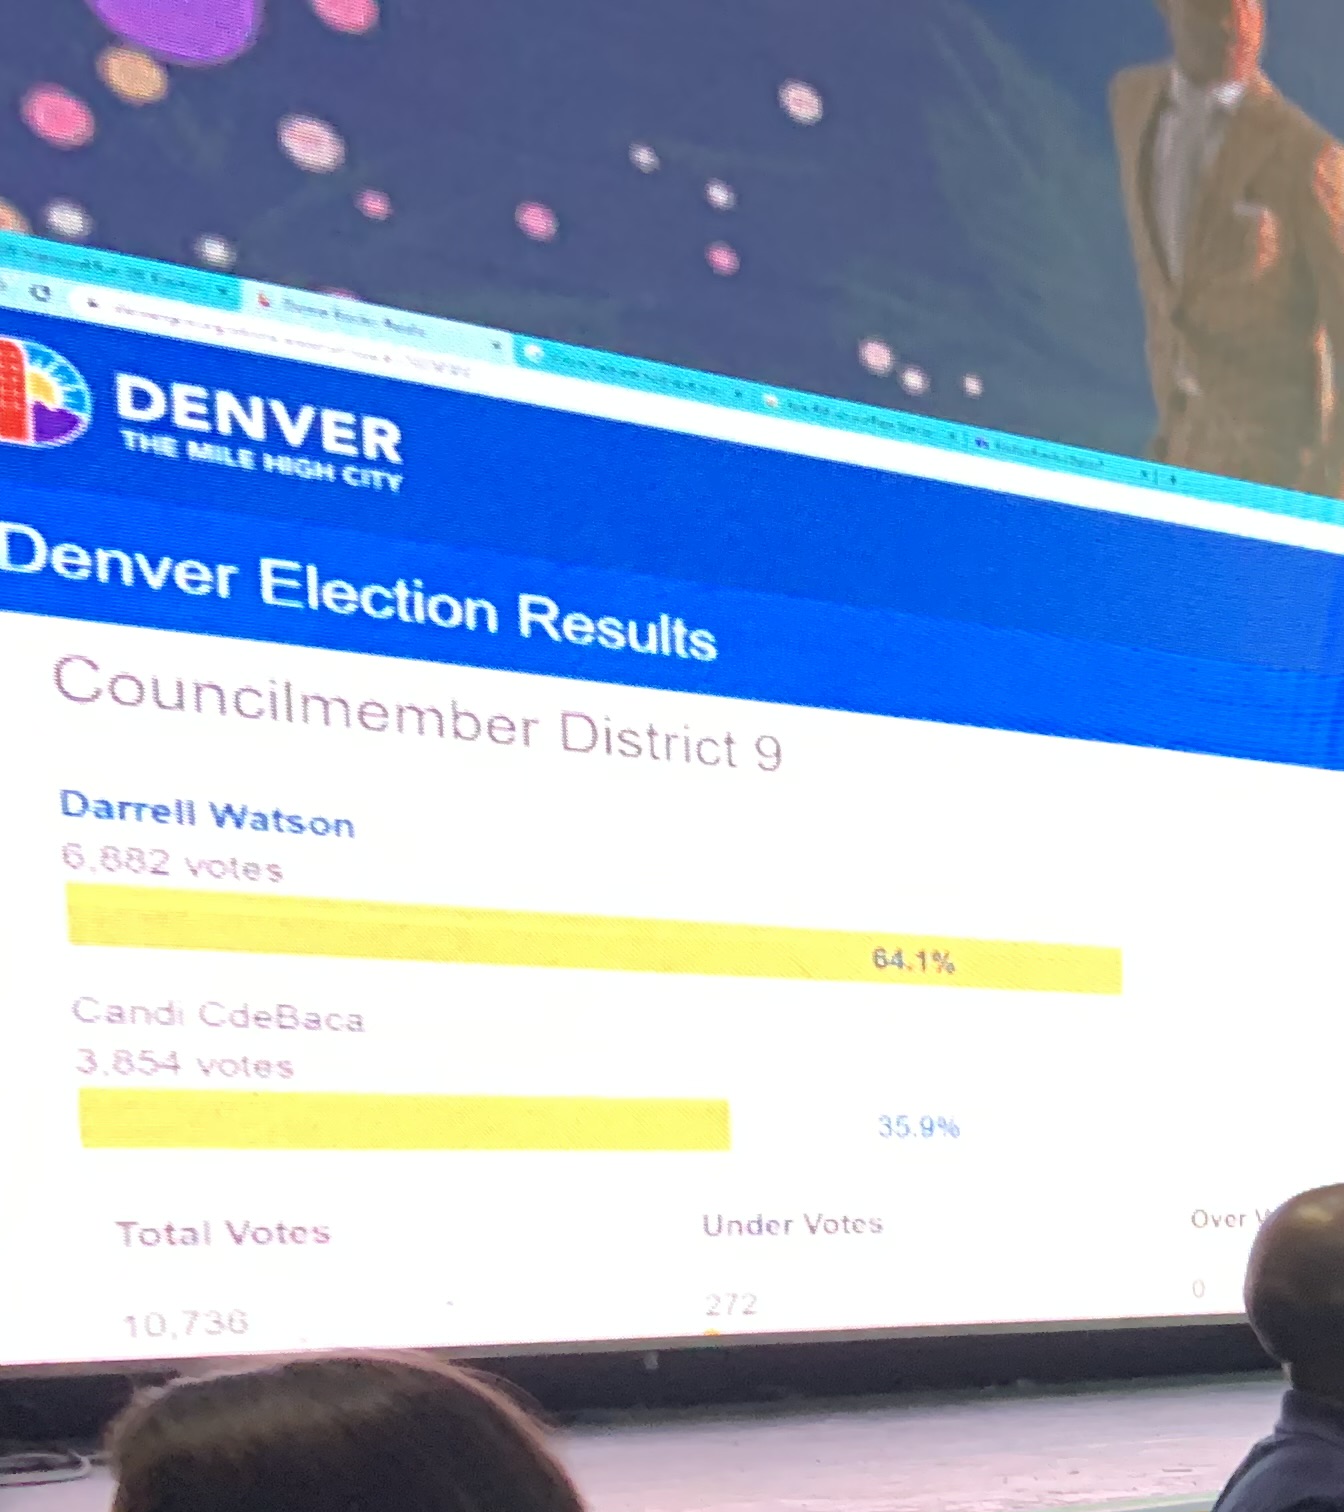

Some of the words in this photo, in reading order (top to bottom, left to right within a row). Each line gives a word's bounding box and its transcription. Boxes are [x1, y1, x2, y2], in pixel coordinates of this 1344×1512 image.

[114, 372, 404, 464] DENVER
[121, 428, 180, 460] THE
[187, 438, 256, 471] MILE
[262, 449, 335, 485] HIGH
[341, 463, 405, 494] CITY
[0, 521, 239, 599] Denver
[259, 557, 500, 634] Election
[518, 593, 718, 663] Results
[53, 654, 540, 750] Councilmember
[560, 711, 738, 769] District
[755, 736, 783, 773] 9
[59, 789, 197, 829] Darrell
[208, 800, 357, 840] Watson
[184, 854, 285, 884] votes
[872, 946, 956, 975] 64.1%
[71, 995, 185, 1027] Candi
[198, 1001, 366, 1034] CdeBaca
[196, 1053, 295, 1080] votes
[877, 1114, 961, 1139] 35.9%
[115, 1218, 210, 1249] Total
[225, 1218, 331, 1247] Votes
[702, 1213, 794, 1238] Under
[803, 1212, 884, 1236] Votes
[1191, 1208, 1246, 1229] Over
[704, 1292, 758, 1318] 272
